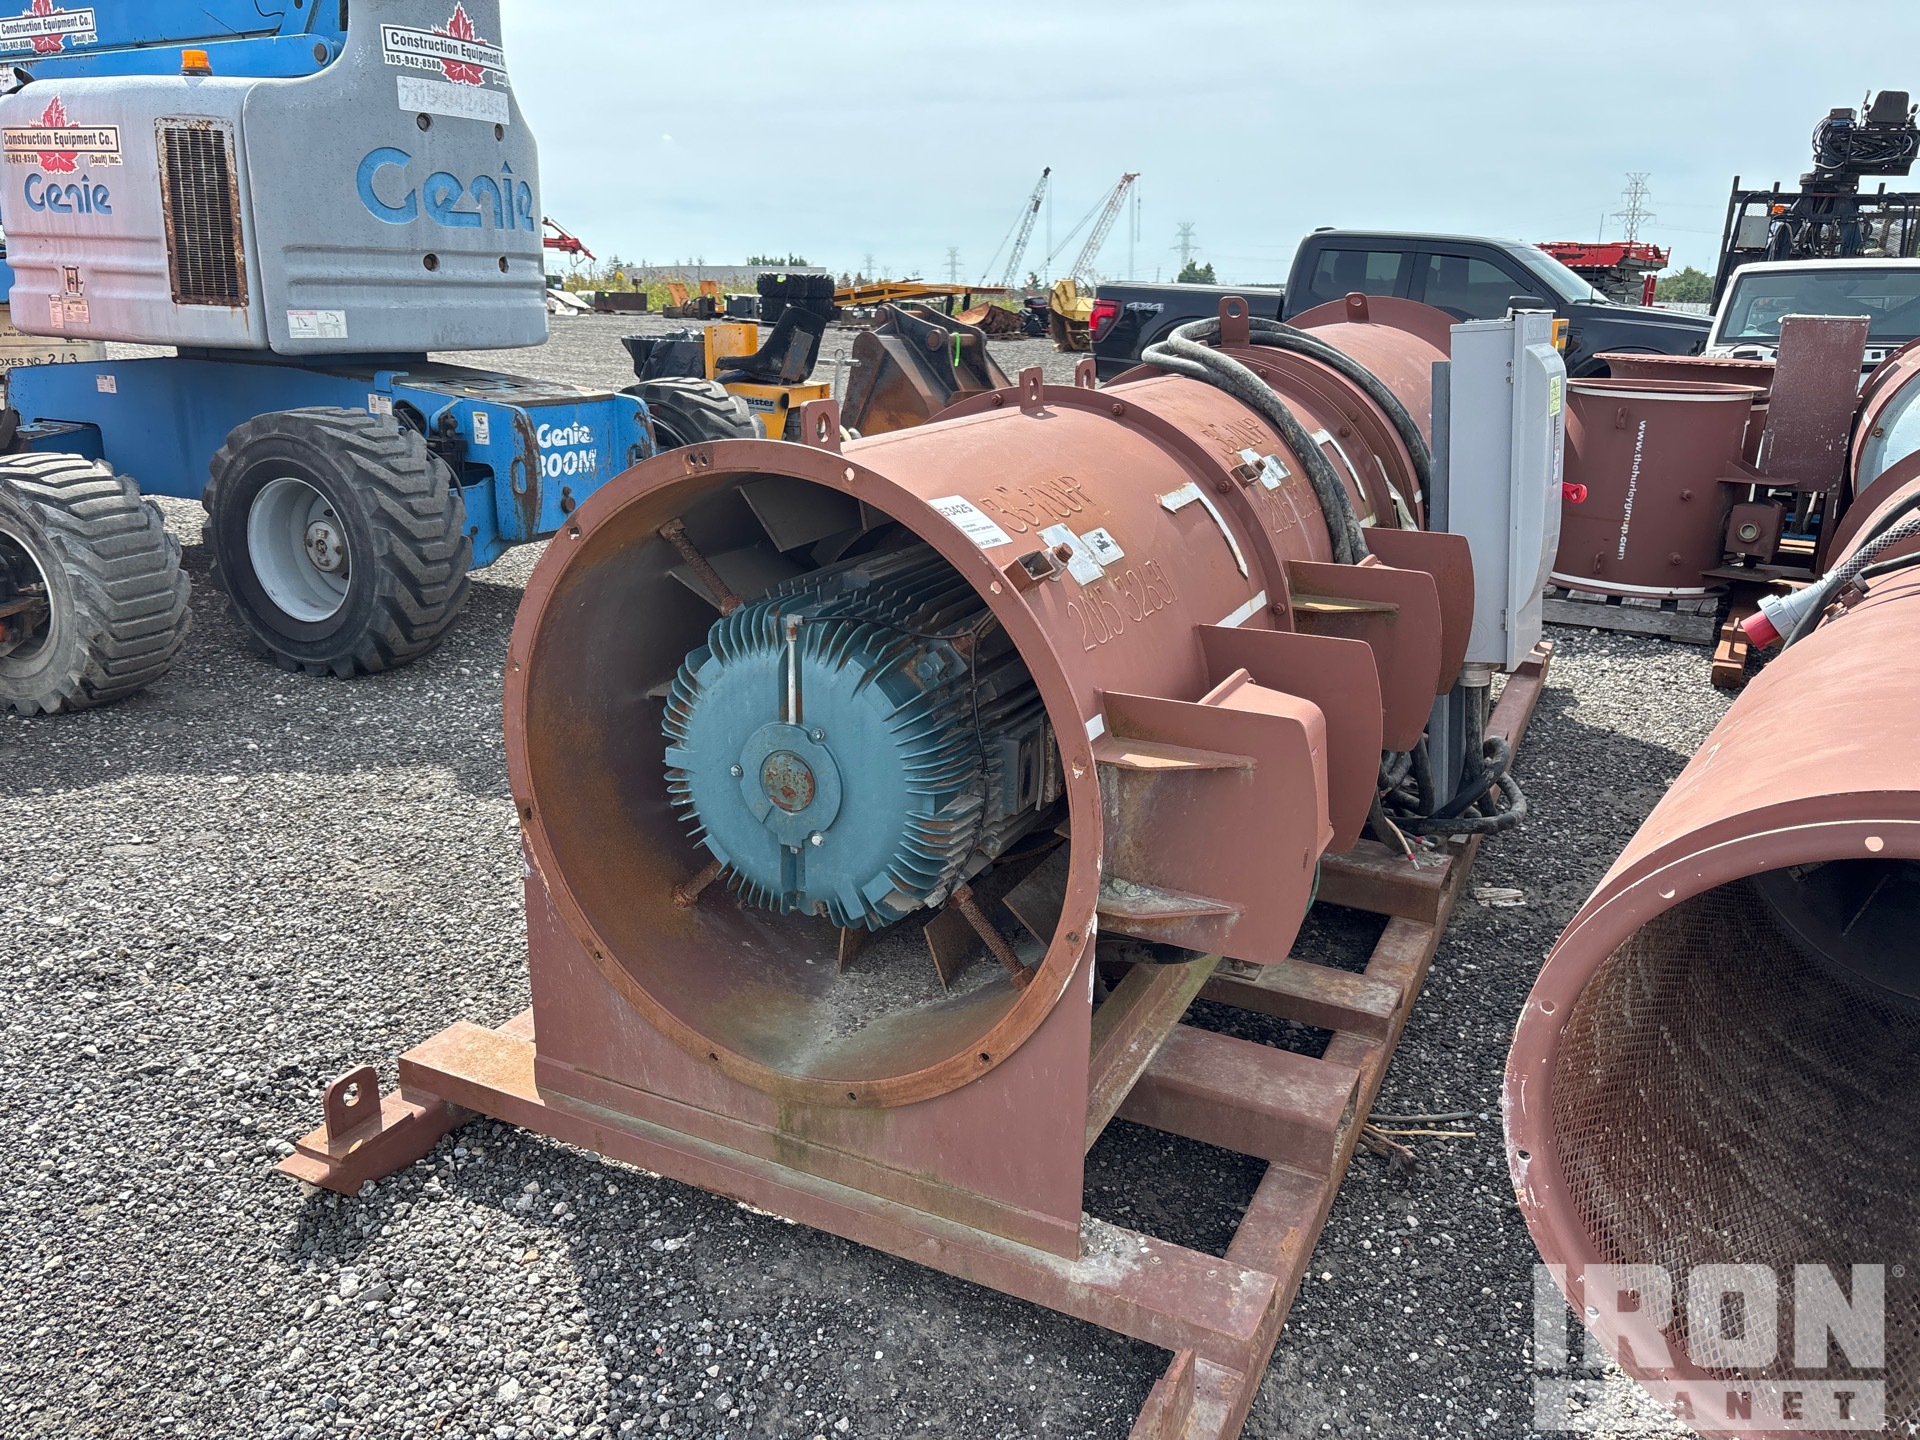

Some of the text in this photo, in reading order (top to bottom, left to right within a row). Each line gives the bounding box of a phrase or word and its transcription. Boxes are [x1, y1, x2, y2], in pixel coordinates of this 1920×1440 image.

[1, 15, 91, 35] Construction Equipment Co.
[386, 54, 441, 69] 705-942-8500
[391, 32, 459, 56] Construction
[461, 44, 500, 64] Equipment
[4, 132, 113, 148] Construction Equipment Co.
[24, 173, 112, 215] Genie
[356, 146, 535, 232] Genie
[536, 421, 594, 449] Genie
[1067, 586, 1124, 652] 2015
